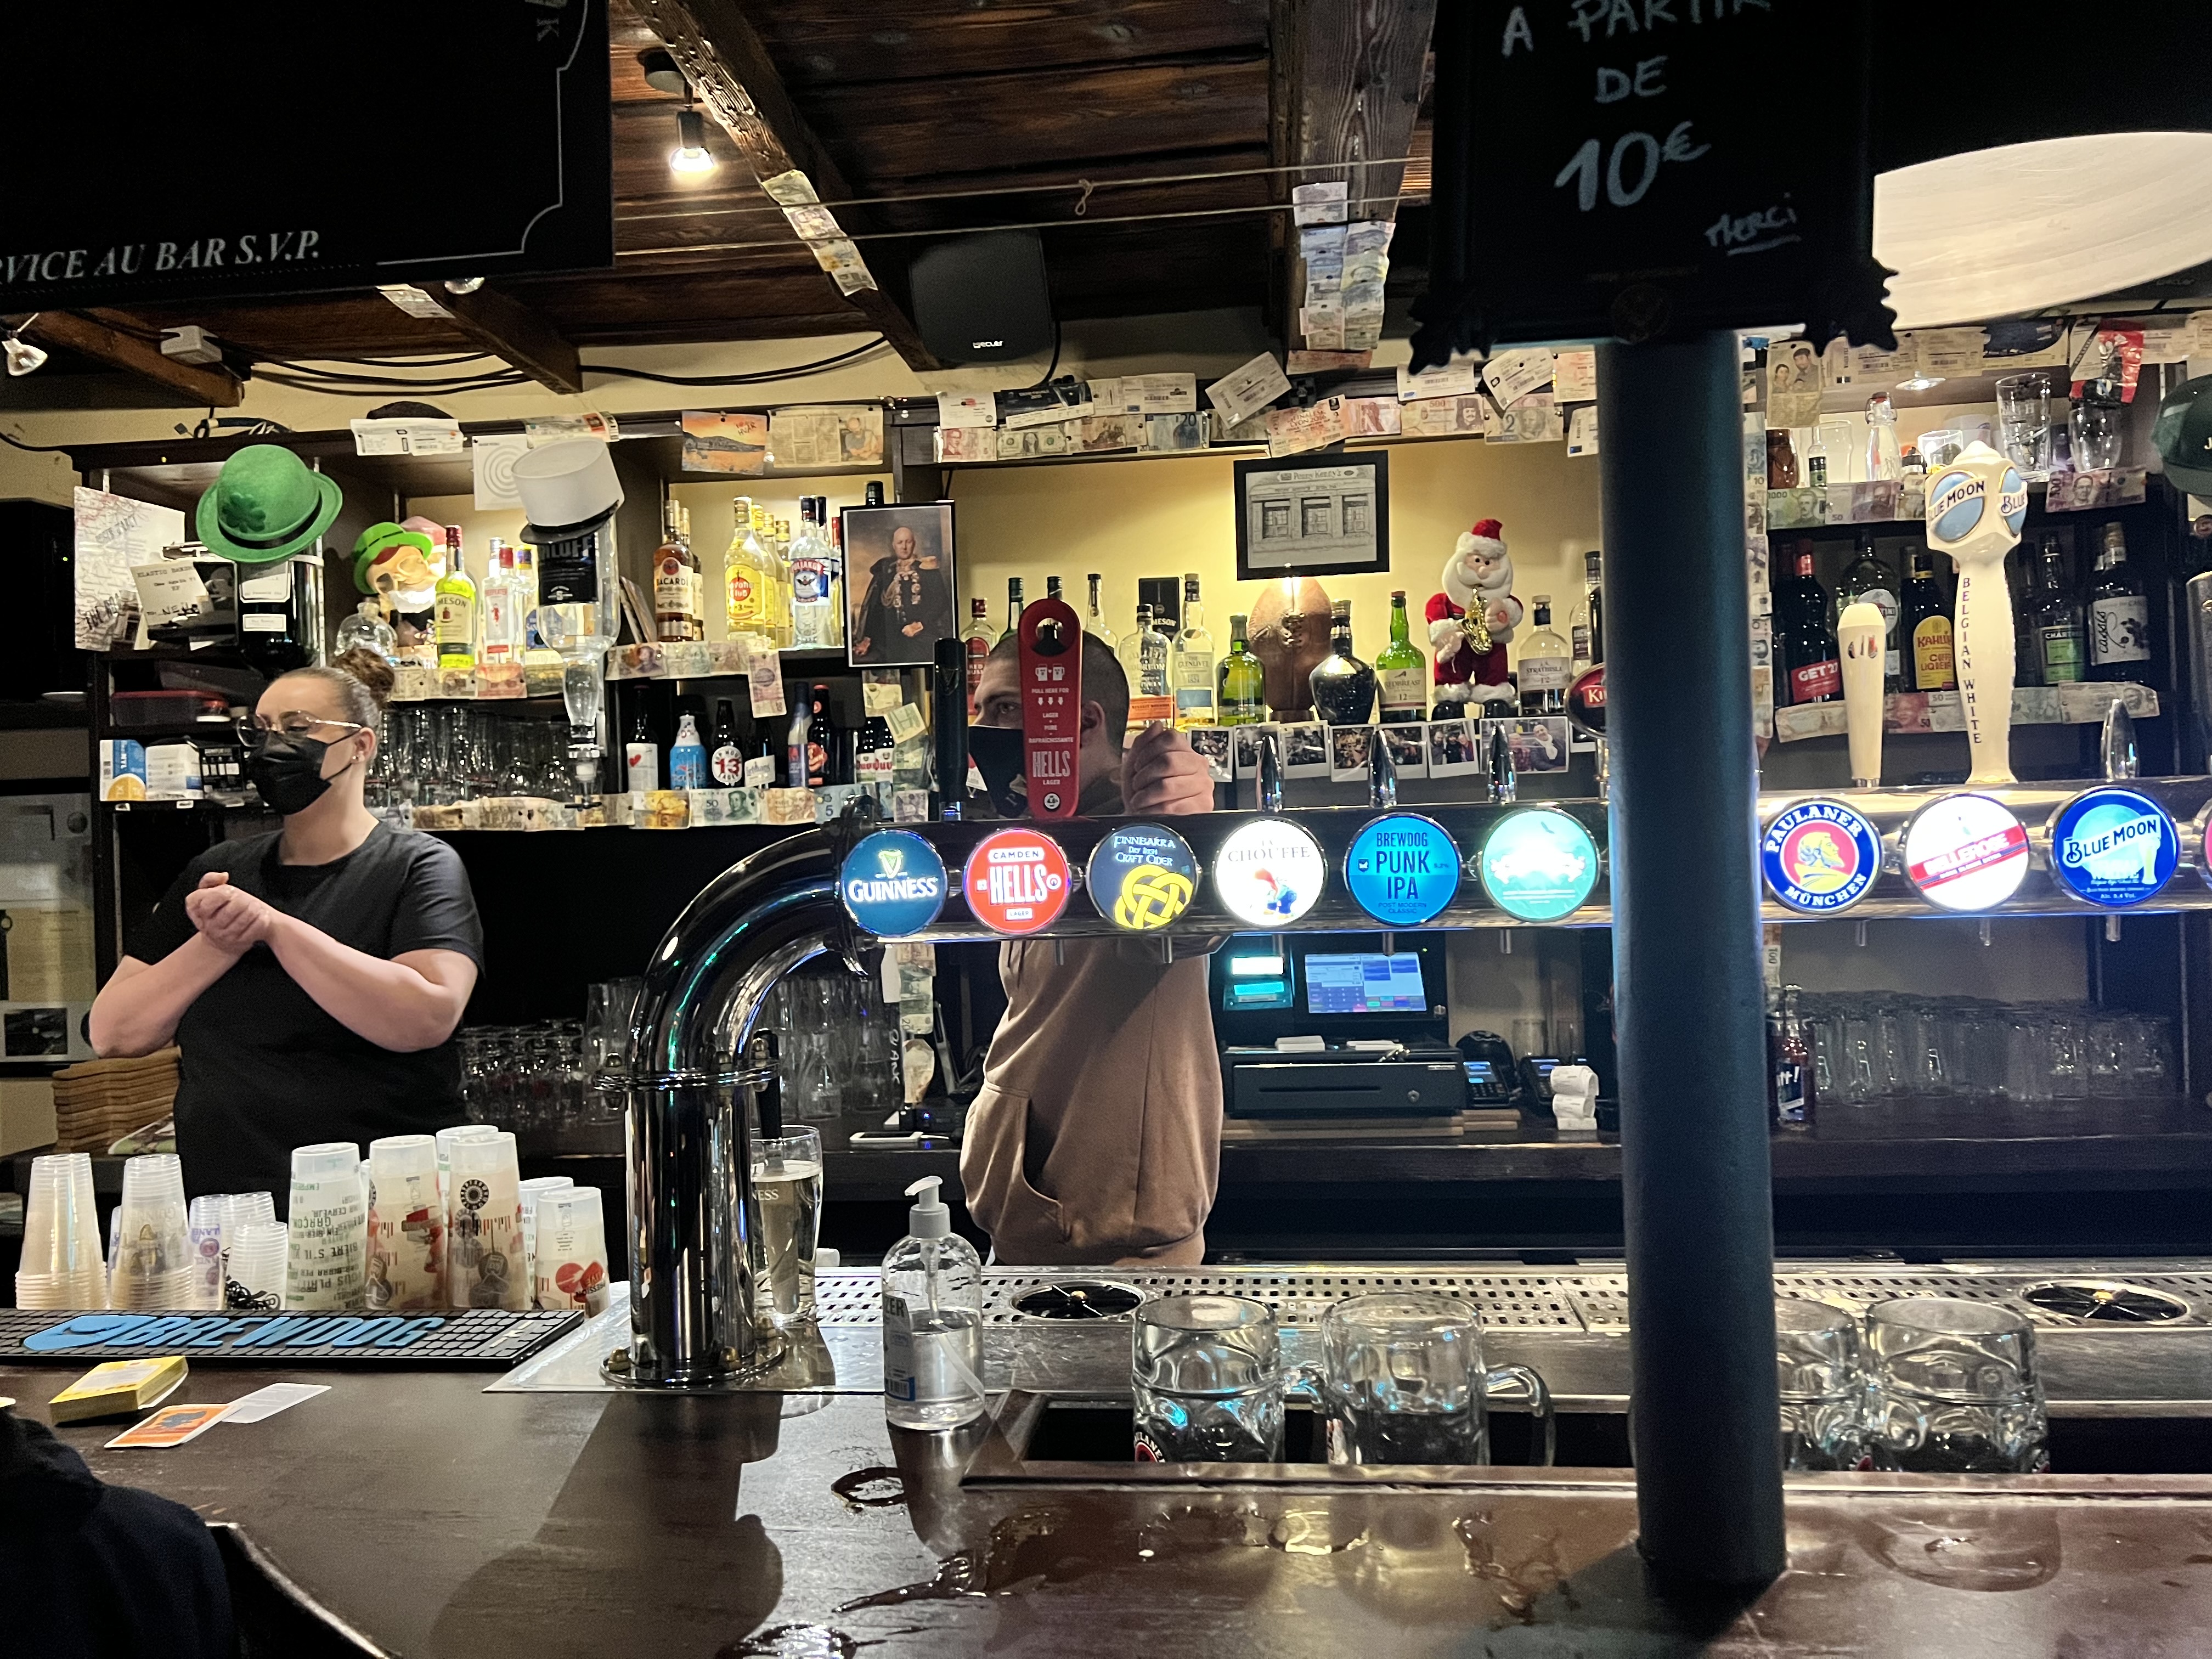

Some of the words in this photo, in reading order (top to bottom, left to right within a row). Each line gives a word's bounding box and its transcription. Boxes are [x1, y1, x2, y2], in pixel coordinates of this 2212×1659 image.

[1594, 55, 1668, 104] DE
[1554, 120, 1712, 212] 10€
[0, 249, 88, 284] VICE
[94, 244, 146, 275] AU
[155, 238, 227, 271] BAR
[235, 229, 319, 264] S.V.P.
[1429, 400, 1446, 408] 500
[1181, 413, 1197, 427] 20
[1505, 414, 1515, 432] 2
[1753, 477, 1765, 486] 10
[1947, 481, 1985, 507] MOON
[2001, 492, 2025, 514] BLUE
[1152, 618, 1176, 627] MESON
[1961, 577, 1971, 670] BELGIAN
[1798, 665, 1826, 681] GET
[1963, 678, 1982, 743] WHITE
[715, 758, 741, 774] 13
[1032, 751, 1070, 777] HELLS
[706, 799, 718, 808] 50
[825, 804, 833, 816] 5
[1376, 832, 1428, 847] BREWDOG
[1765, 805, 1863, 853] PAULANER
[1113, 836, 1176, 849] FINNBARRA
[2066, 836, 2110, 864] BLUE
[2113, 819, 2157, 845] MOON
[993, 850, 1039, 859] CAMDEN
[1228, 847, 1310, 862] CHOUFFE
[1376, 851, 1430, 873] PUNK
[849, 877, 938, 902] GUINNESS
[990, 864, 1048, 904] HELLS
[1387, 876, 1419, 899] IPA
[1784, 873, 1867, 906] MÜNCHEN
[101, 1316, 447, 1349] BREWDOG
